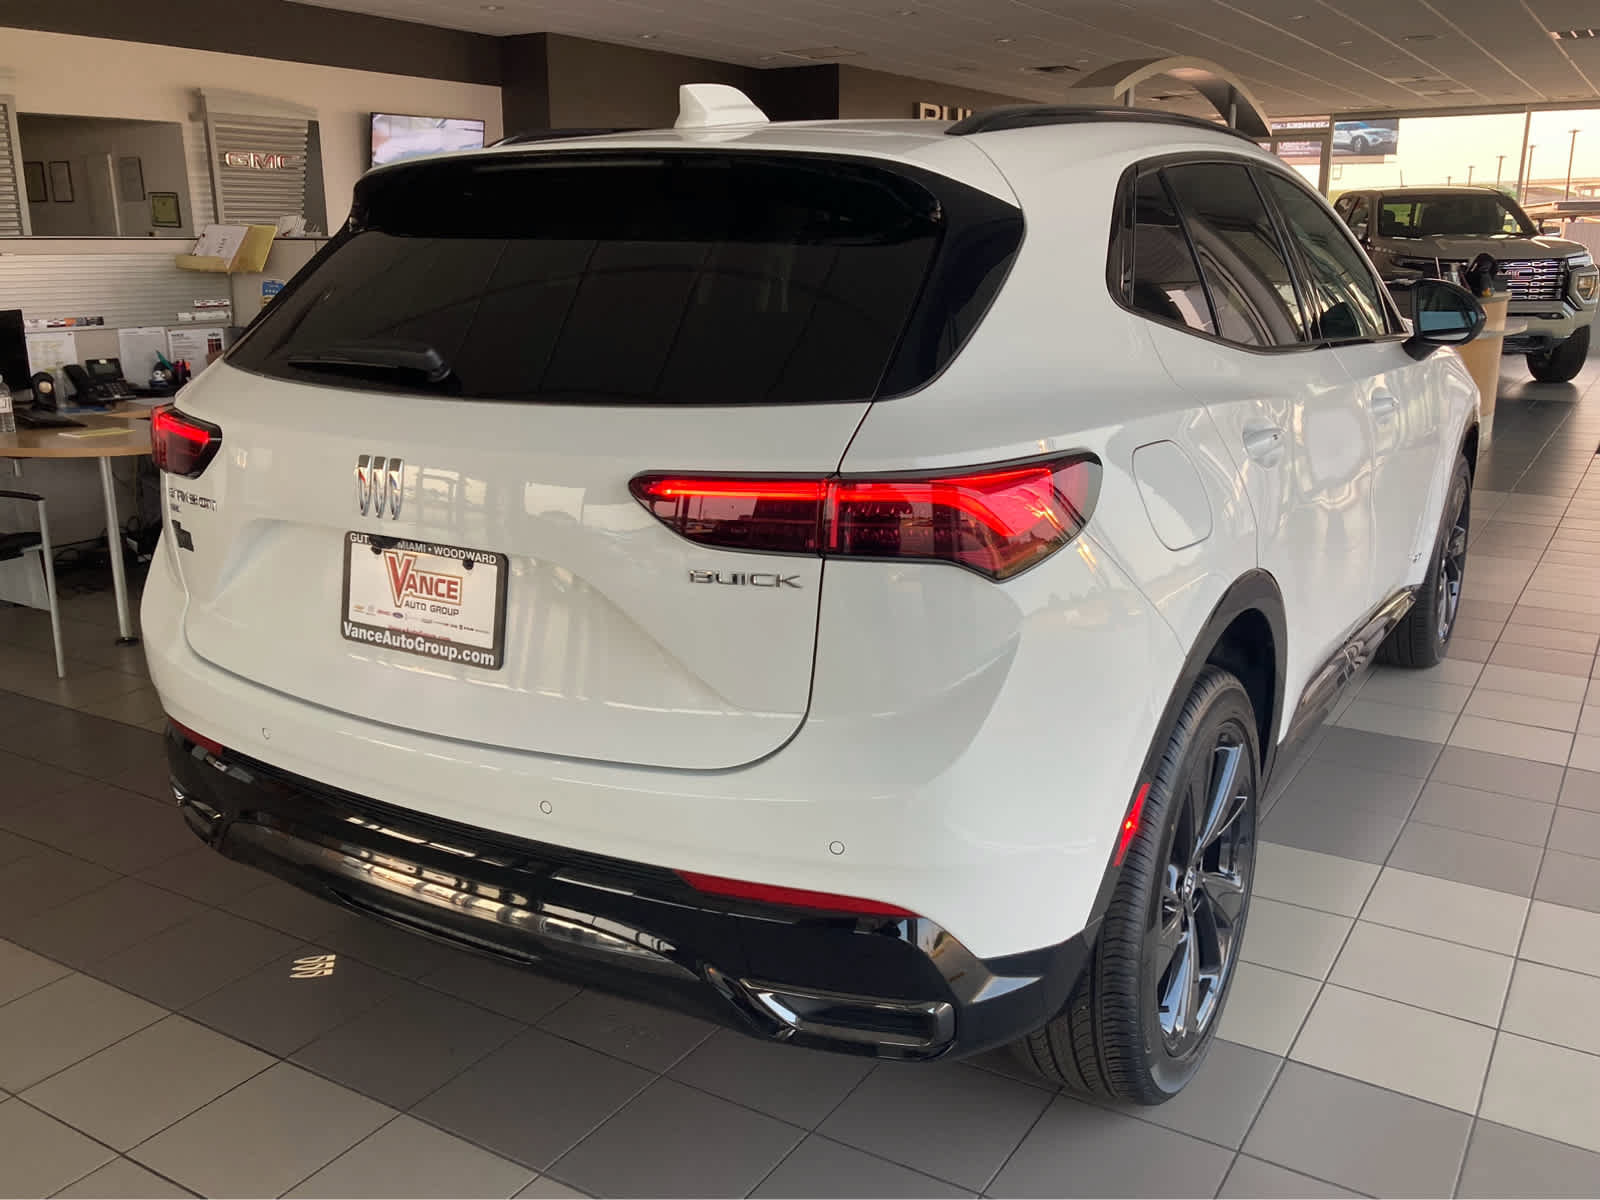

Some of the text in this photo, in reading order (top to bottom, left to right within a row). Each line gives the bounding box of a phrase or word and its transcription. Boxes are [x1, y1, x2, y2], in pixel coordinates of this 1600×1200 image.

[224, 151, 297, 169] GMC
[397, 541, 426, 553] MIAMI
[434, 546, 496, 564] WOODWARD
[688, 569, 803, 589] BUICK
[404, 600, 459, 616] AUTO GROUP
[343, 621, 495, 666] VanceAutoGroup.com
